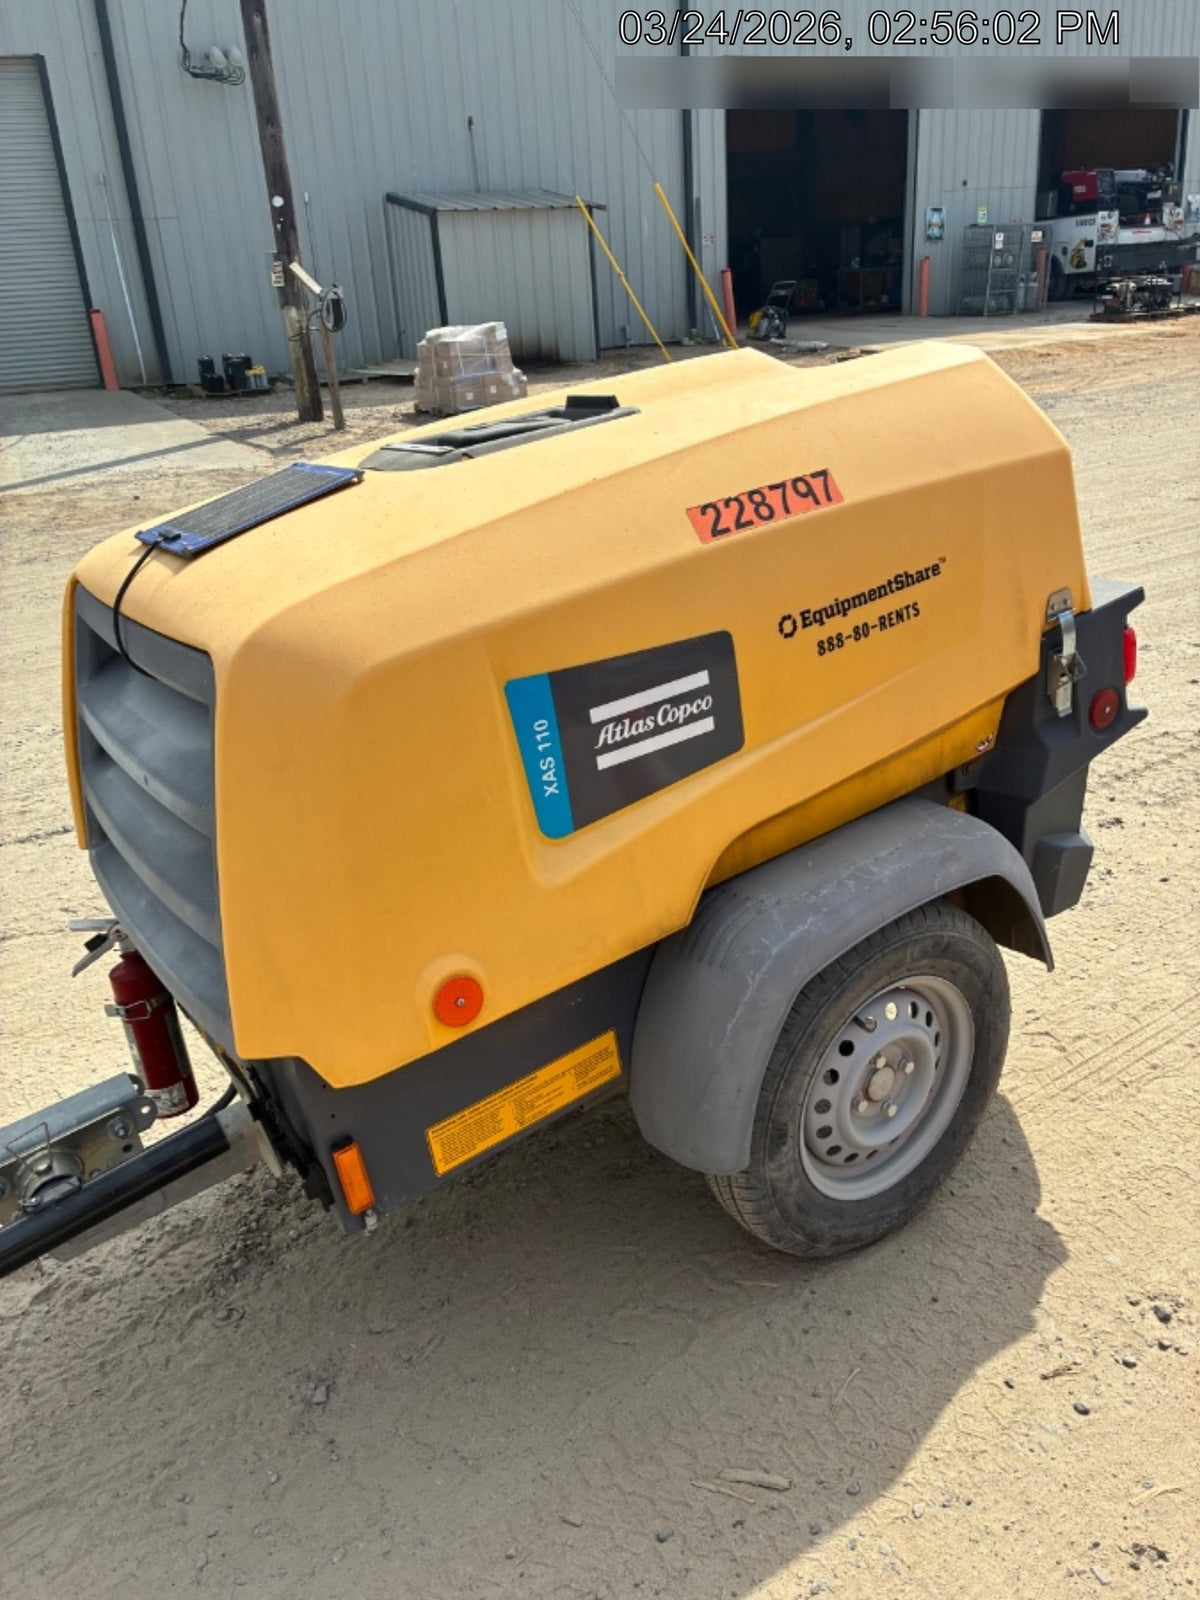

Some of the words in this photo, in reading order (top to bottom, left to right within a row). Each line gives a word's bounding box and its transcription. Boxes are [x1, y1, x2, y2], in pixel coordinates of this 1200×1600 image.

[700, 468, 834, 538] 228797
[816, 602, 921, 657] 888-80-RENTS
[532, 718, 552, 753] 110
[594, 715, 655, 750] Atlas
[657, 695, 714, 729] Copco
[539, 756, 560, 798] XAS
